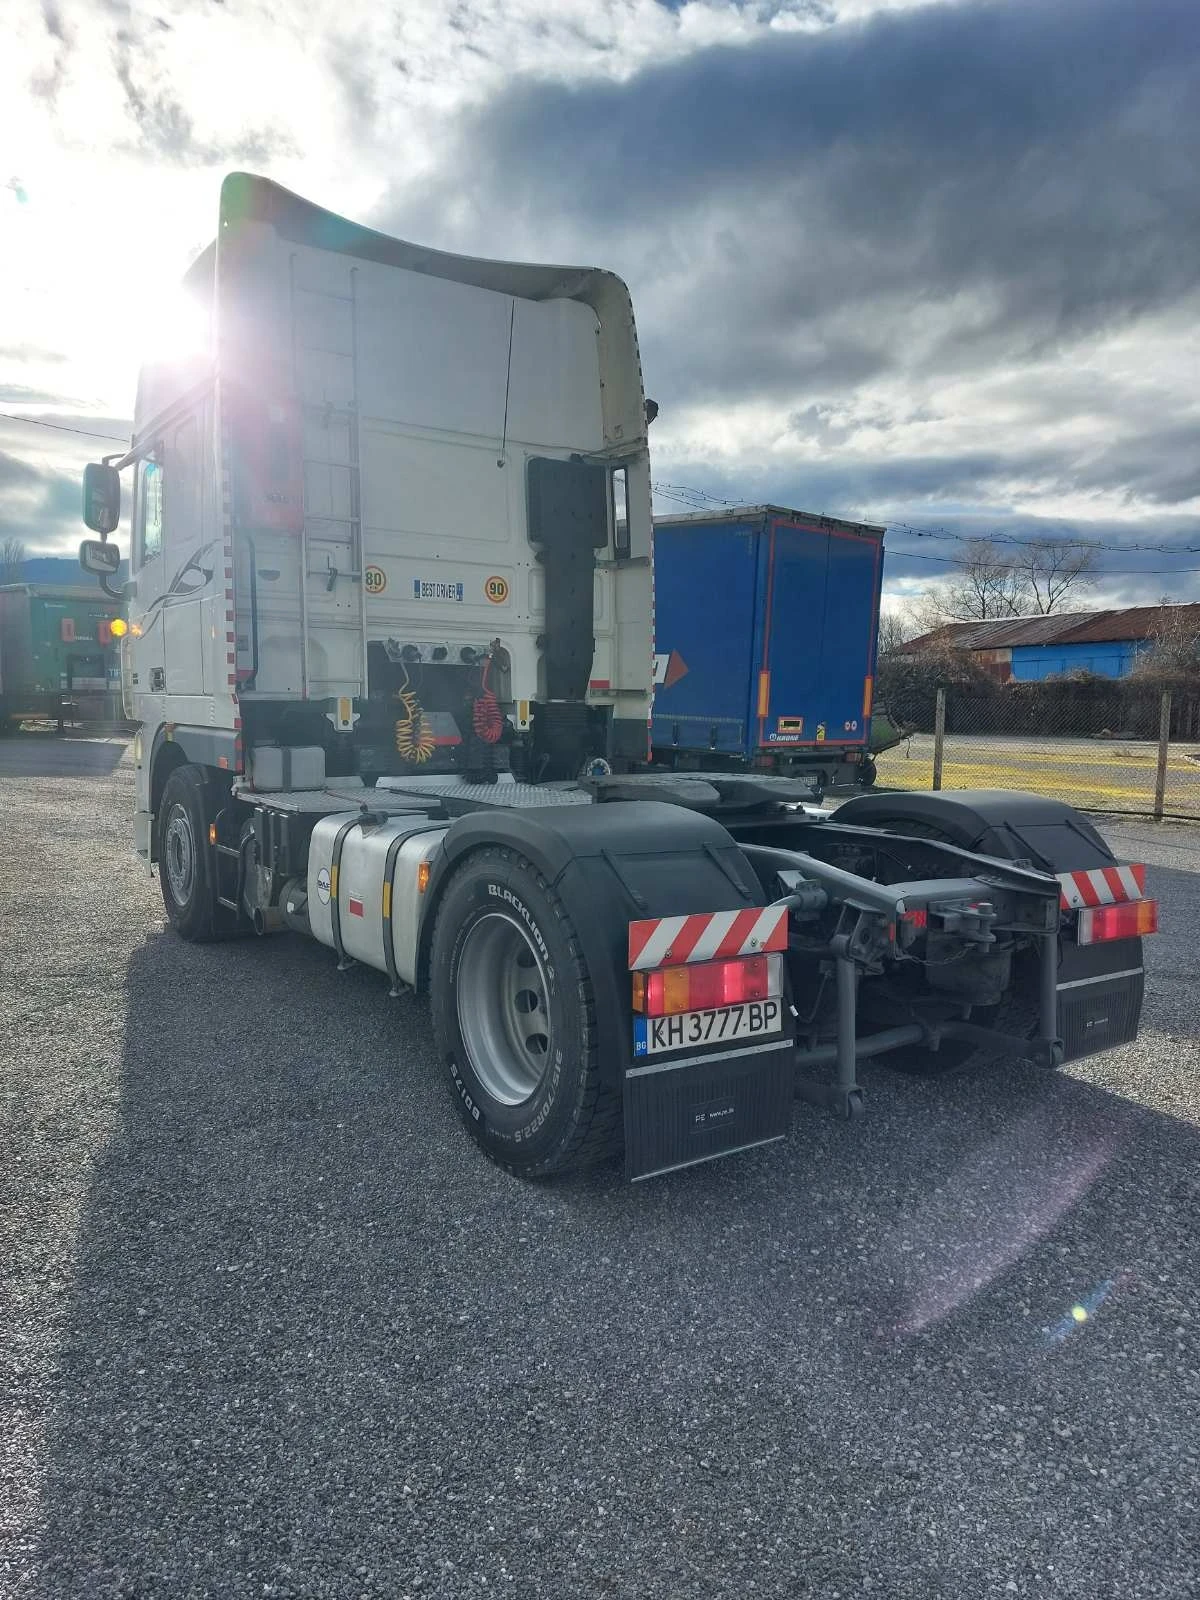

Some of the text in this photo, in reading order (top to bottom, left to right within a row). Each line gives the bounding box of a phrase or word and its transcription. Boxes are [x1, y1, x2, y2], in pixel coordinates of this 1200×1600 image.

[366, 572, 382, 585] 80
[421, 582, 456, 599] BEST DRIVER
[489, 582, 504, 596] 90
[636, 1041, 647, 1051] BG
